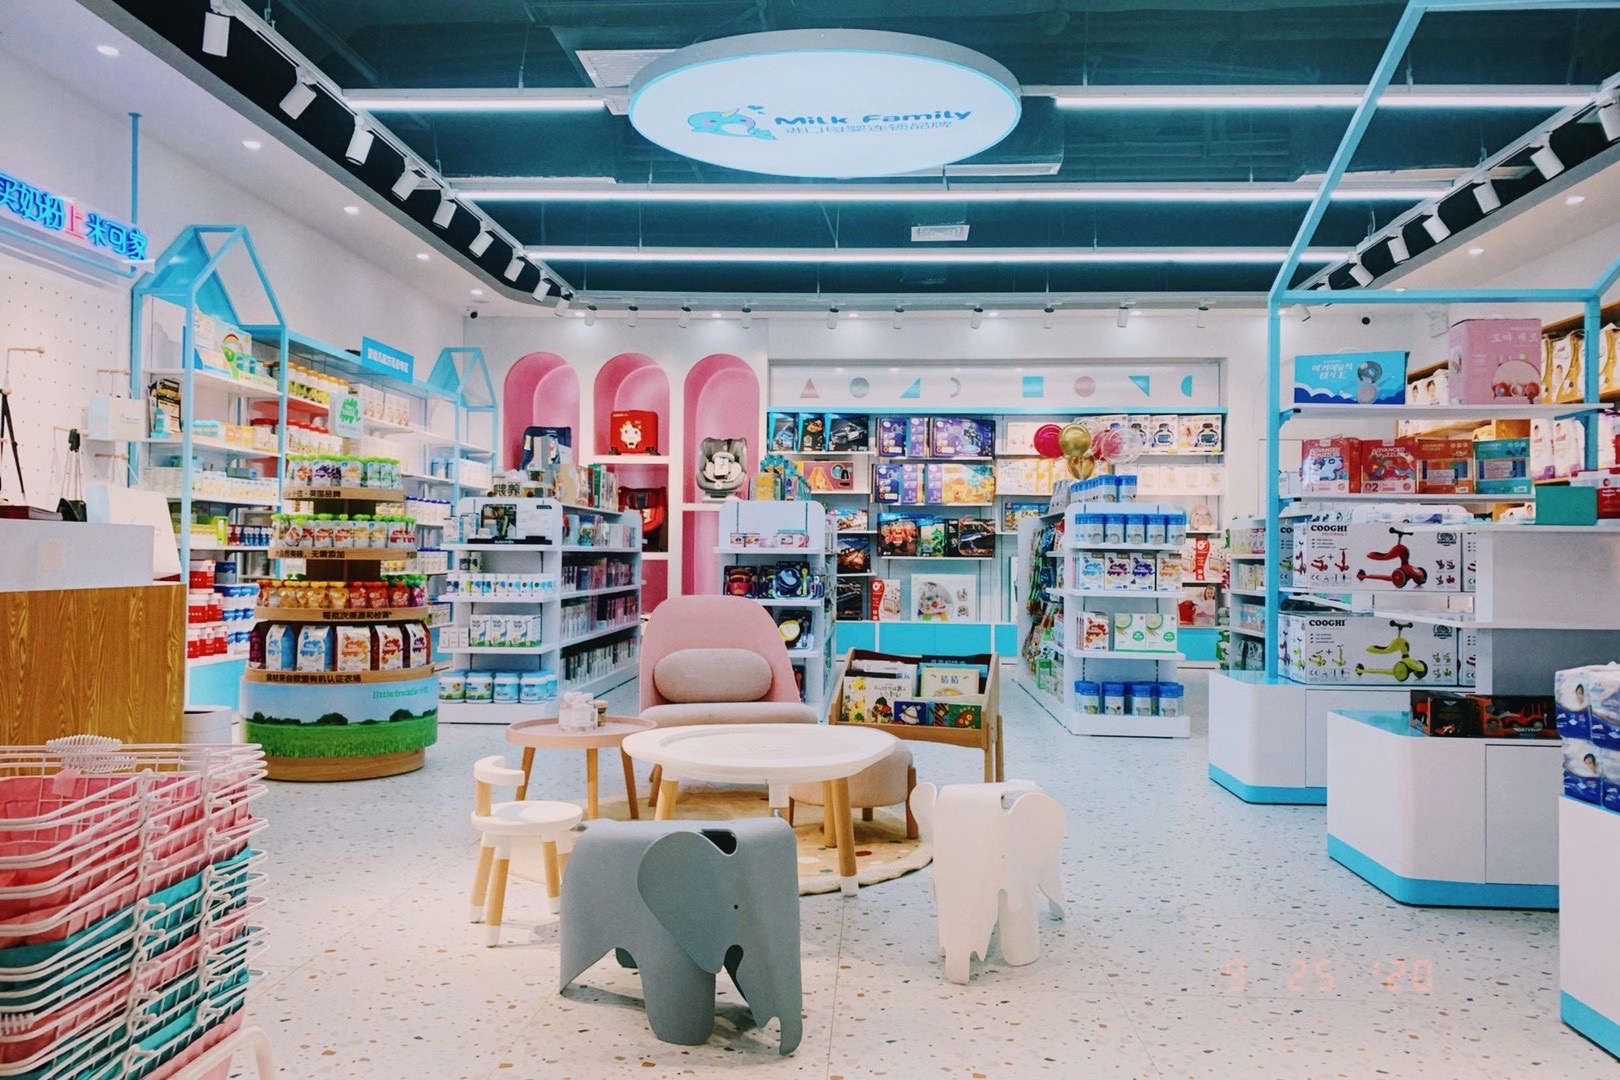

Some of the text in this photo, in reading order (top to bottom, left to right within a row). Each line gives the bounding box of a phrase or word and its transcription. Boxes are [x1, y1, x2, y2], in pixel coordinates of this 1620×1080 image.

[774, 110, 972, 125] Milk Family
[1310, 524, 1348, 532] COOGHI
[1309, 619, 1346, 627] COOGHI
